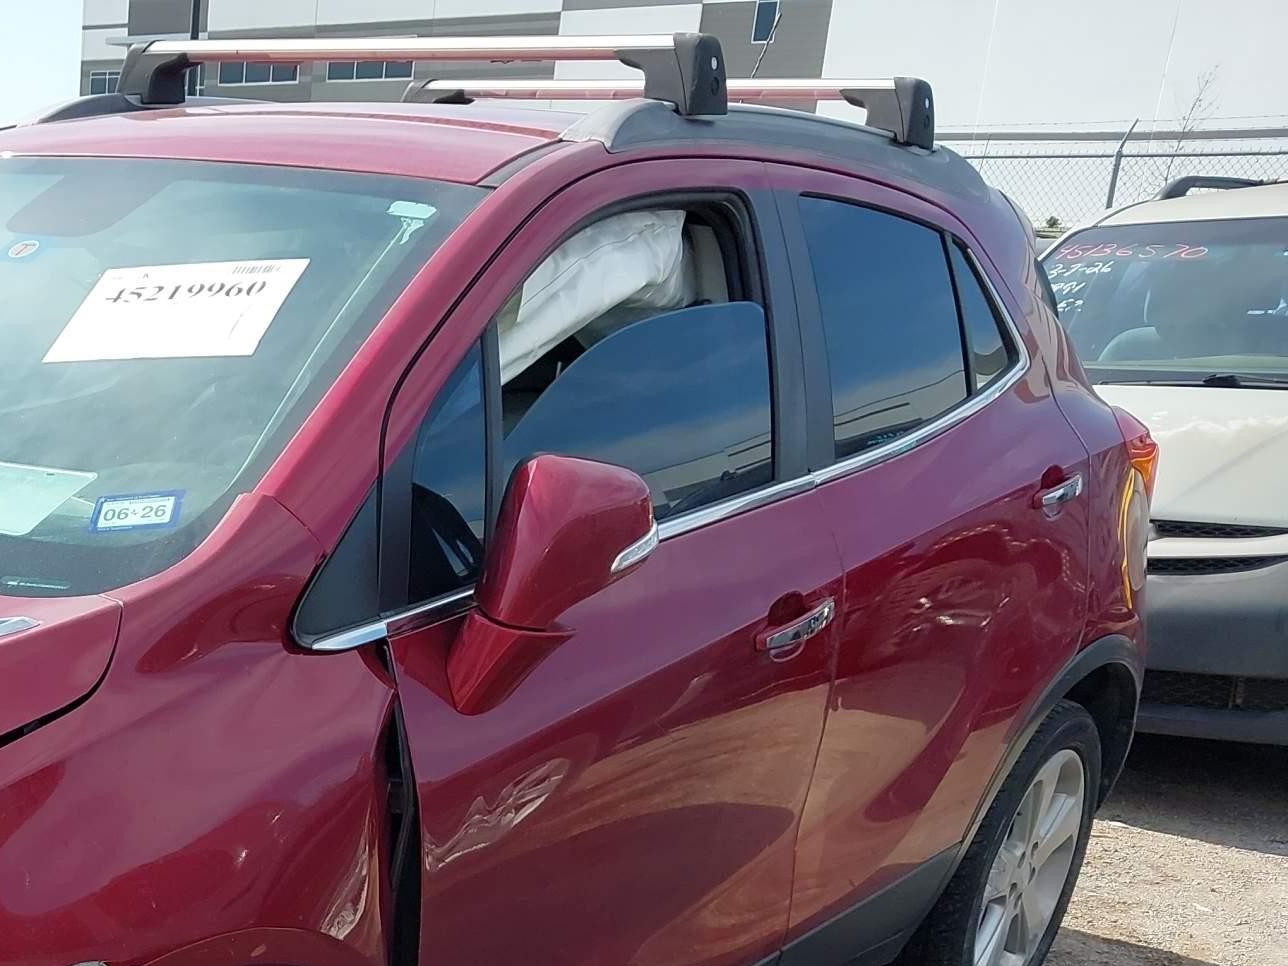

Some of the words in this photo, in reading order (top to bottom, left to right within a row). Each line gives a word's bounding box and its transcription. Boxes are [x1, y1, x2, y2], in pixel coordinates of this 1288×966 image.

[105, 280, 267, 303] 45219960
[103, 507, 130, 522] 06
[140, 504, 167, 519] 26
